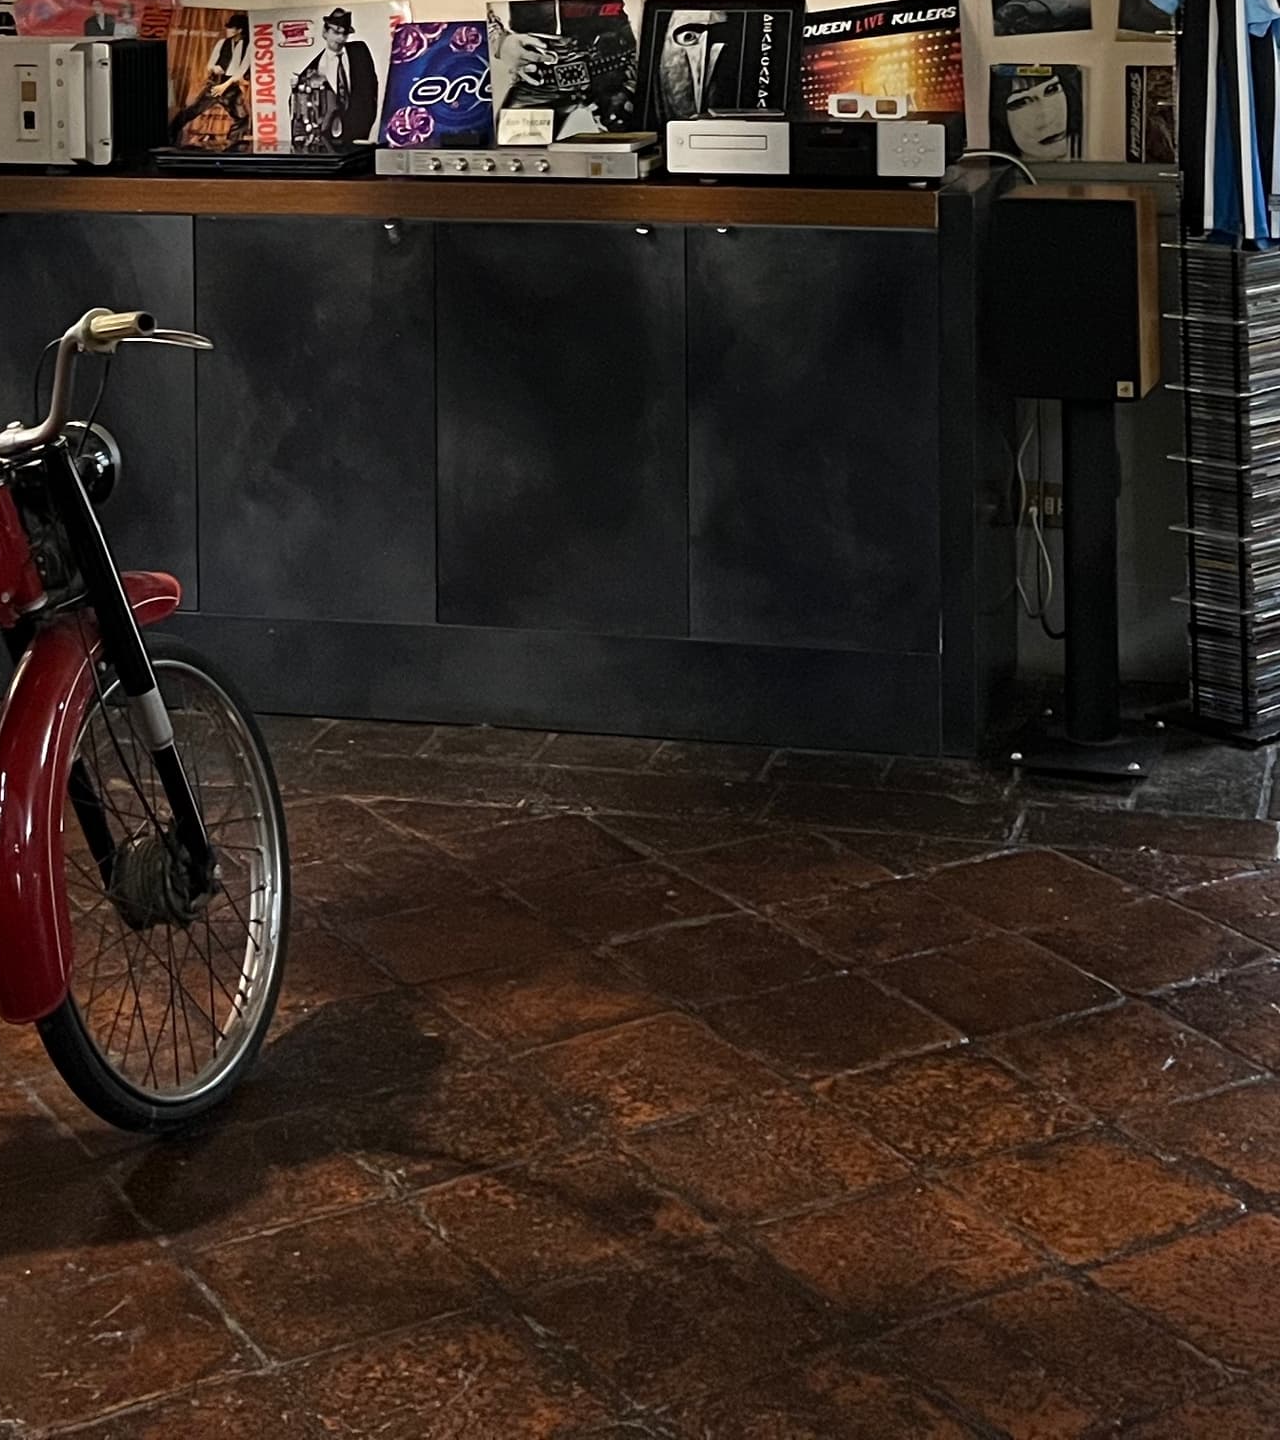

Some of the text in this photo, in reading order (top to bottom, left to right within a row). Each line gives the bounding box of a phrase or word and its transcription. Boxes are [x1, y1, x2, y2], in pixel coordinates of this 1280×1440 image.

[802, 6, 957, 38] QUEEN LIVE KILLERS
[253, 23, 277, 105] JACKSON
